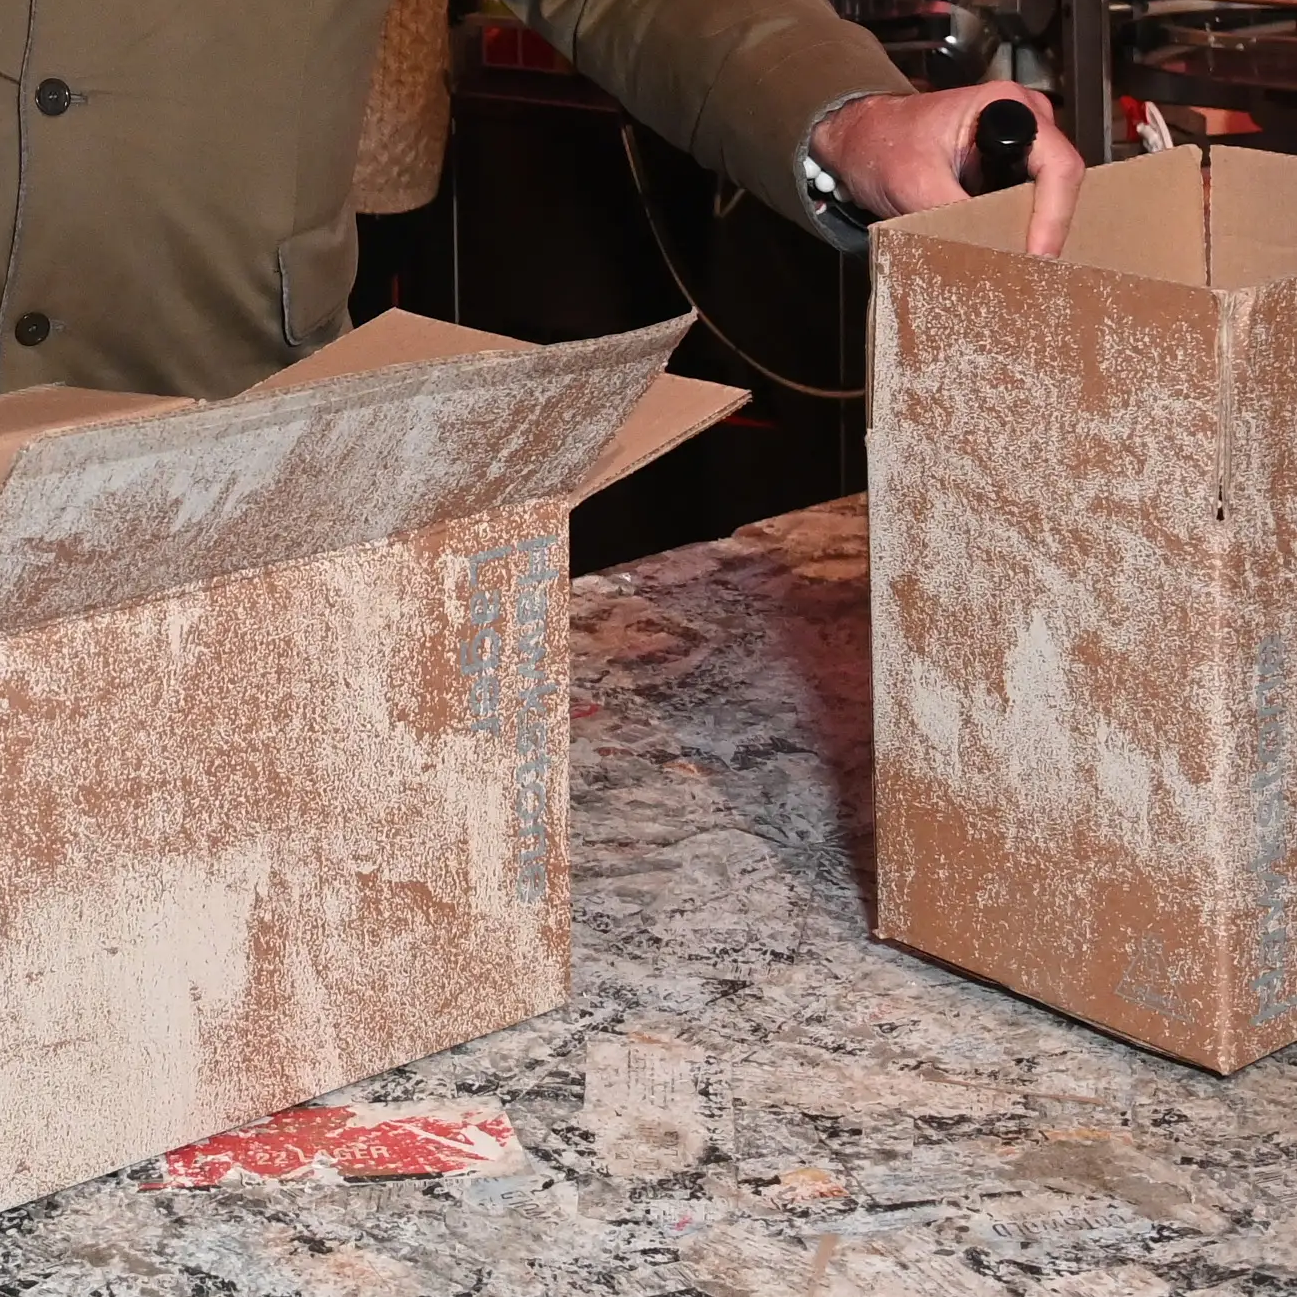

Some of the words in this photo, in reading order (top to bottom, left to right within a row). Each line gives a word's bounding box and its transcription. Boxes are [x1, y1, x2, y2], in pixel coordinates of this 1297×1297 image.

[460, 547, 512, 735] Lager
[514, 536, 559, 905] Hawkstone
[1250, 633, 1287, 1026] Hawkstone
